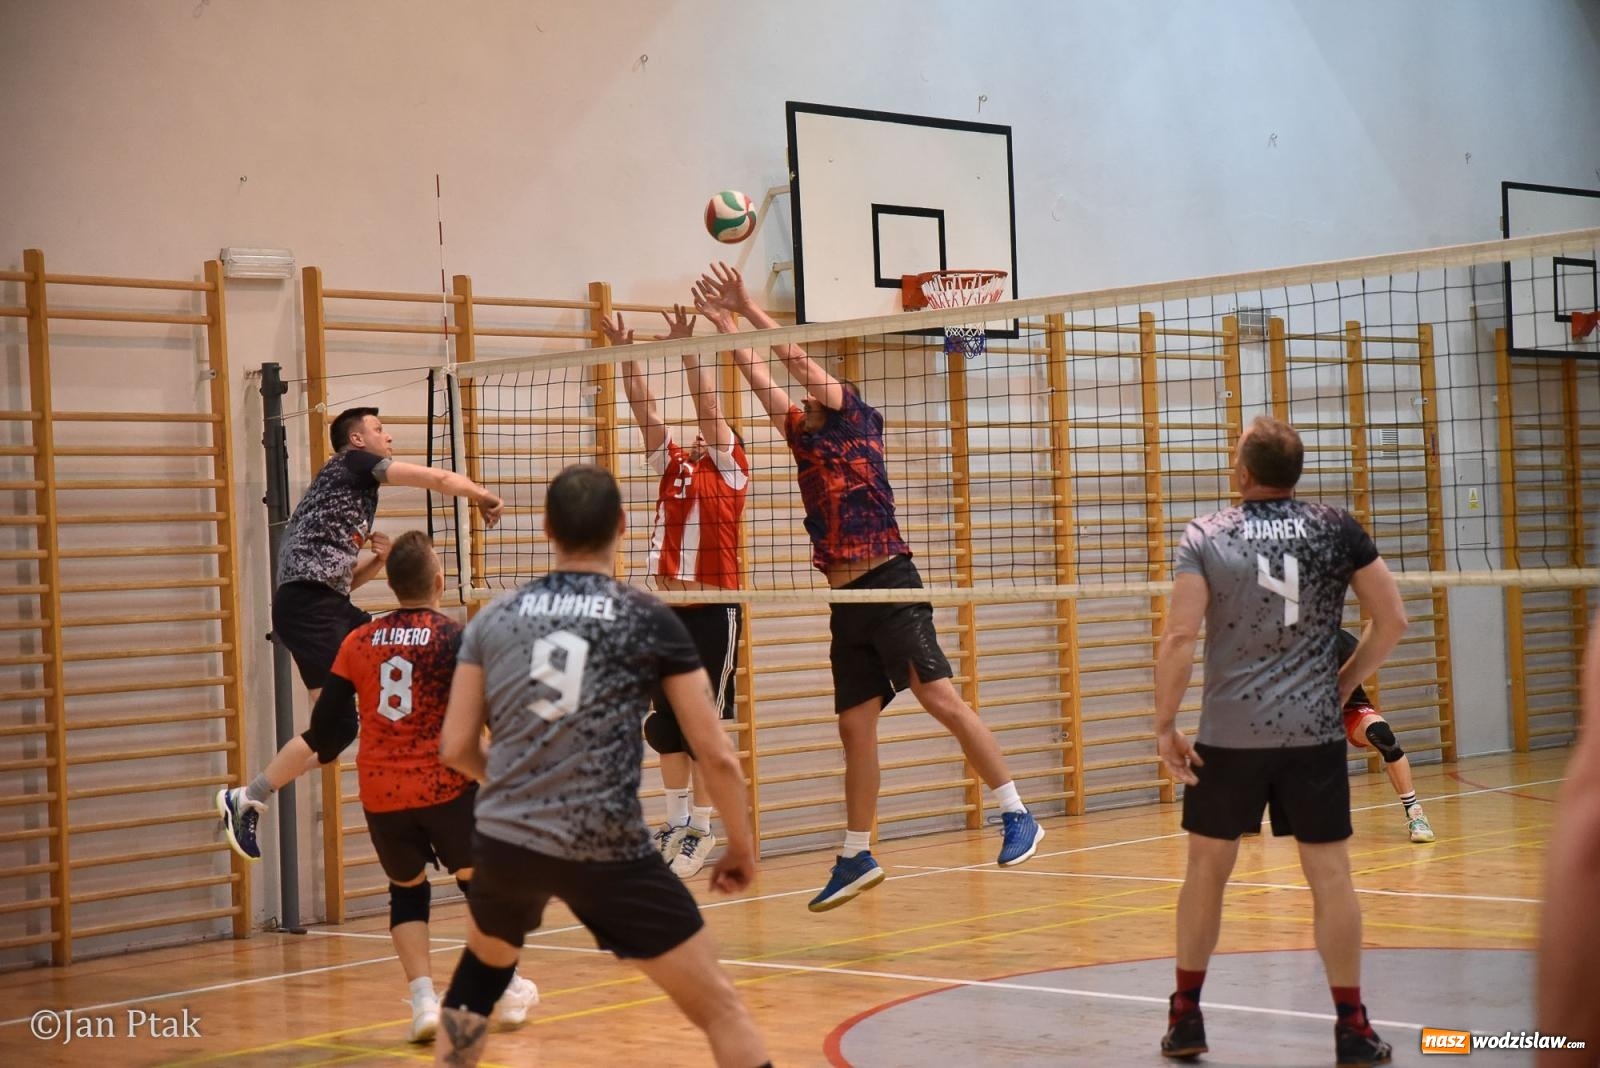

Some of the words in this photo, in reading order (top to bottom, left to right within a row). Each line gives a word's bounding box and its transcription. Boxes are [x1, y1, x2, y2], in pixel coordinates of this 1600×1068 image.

[1243, 518, 1308, 540] #JAREK
[1256, 552, 1299, 627] 4
[377, 655, 413, 721] 8
[526, 630, 590, 721] 9
